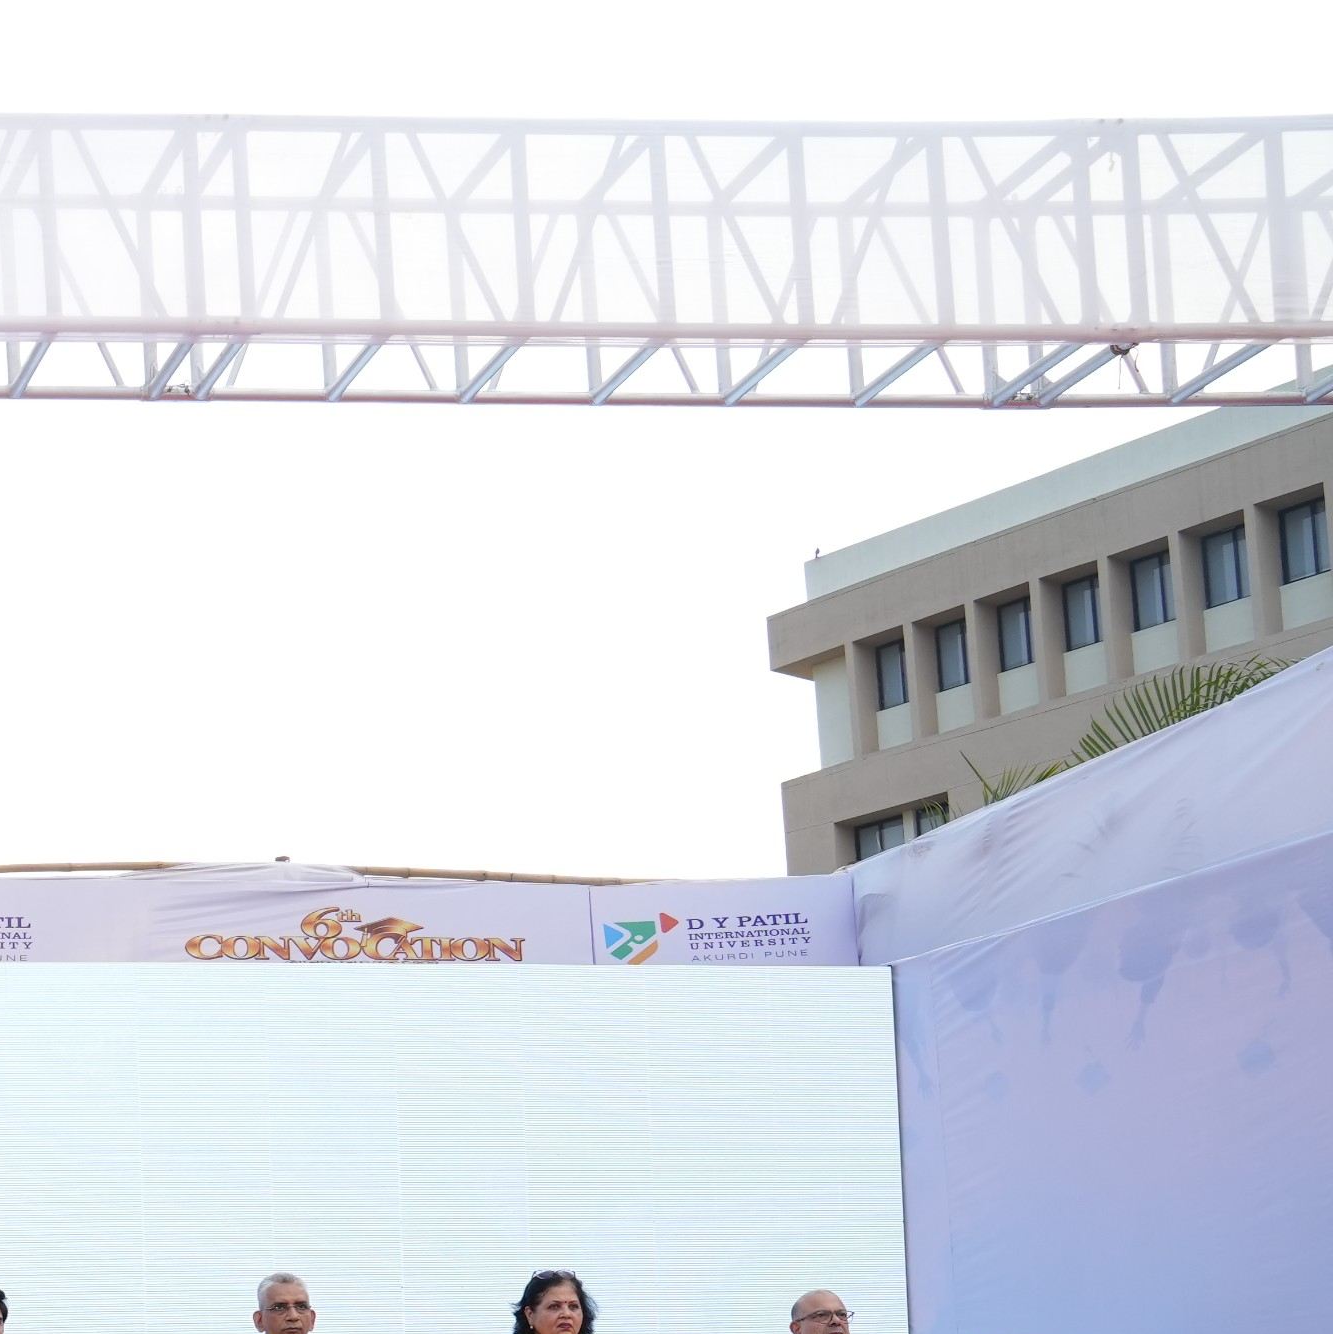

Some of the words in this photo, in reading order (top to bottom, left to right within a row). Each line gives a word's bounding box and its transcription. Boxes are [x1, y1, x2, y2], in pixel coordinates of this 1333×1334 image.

[300, 906, 361, 938] 6th
[686, 919, 704, 930] D
[712, 917, 729, 928] Y
[737, 913, 808, 927] PATIL
[689, 927, 810, 940] INTERNATIONAL
[184, 933, 526, 961] CONVOCATION
[690, 937, 812, 950] UNIVERSITY
[692, 952, 754, 962] AKURDI
[764, 949, 808, 958] PUNE
